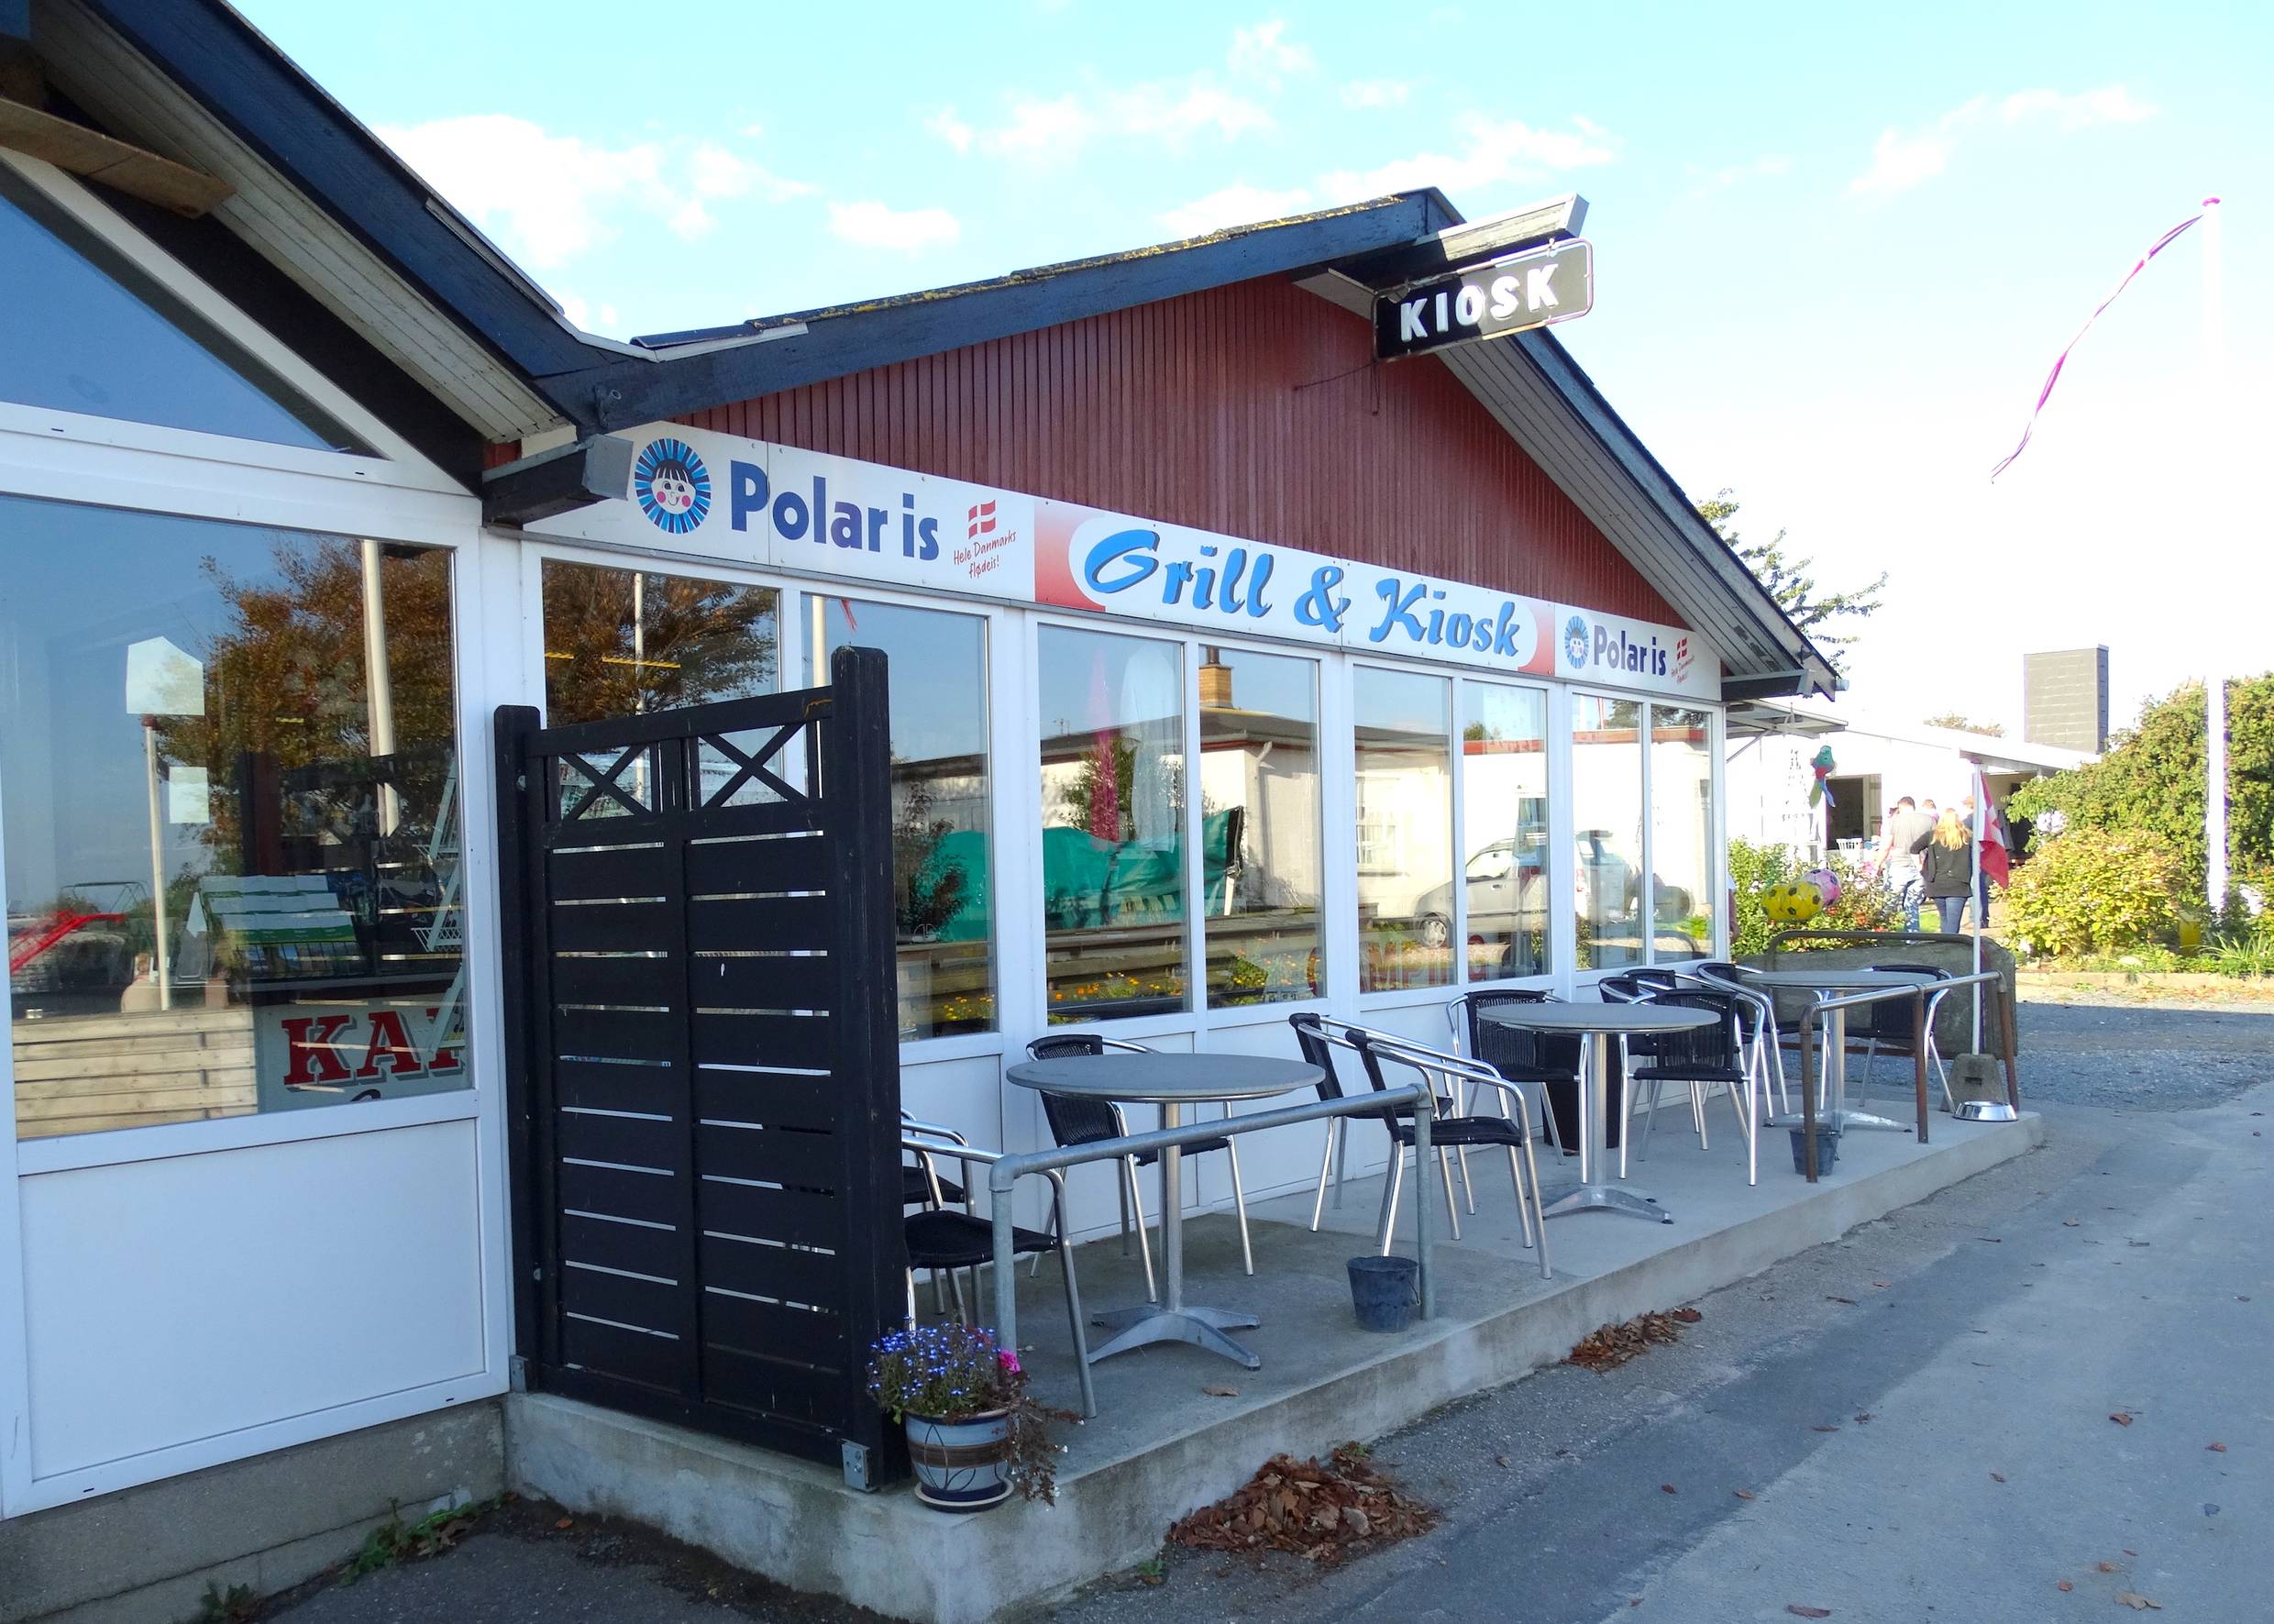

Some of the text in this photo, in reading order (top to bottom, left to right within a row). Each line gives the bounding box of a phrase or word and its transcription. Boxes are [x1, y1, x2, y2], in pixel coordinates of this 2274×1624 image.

[1400, 263, 1559, 342] KIOSK
[953, 529, 1017, 566] Hele Danmarks
[1084, 529, 1520, 656] Grill & Kiosk
